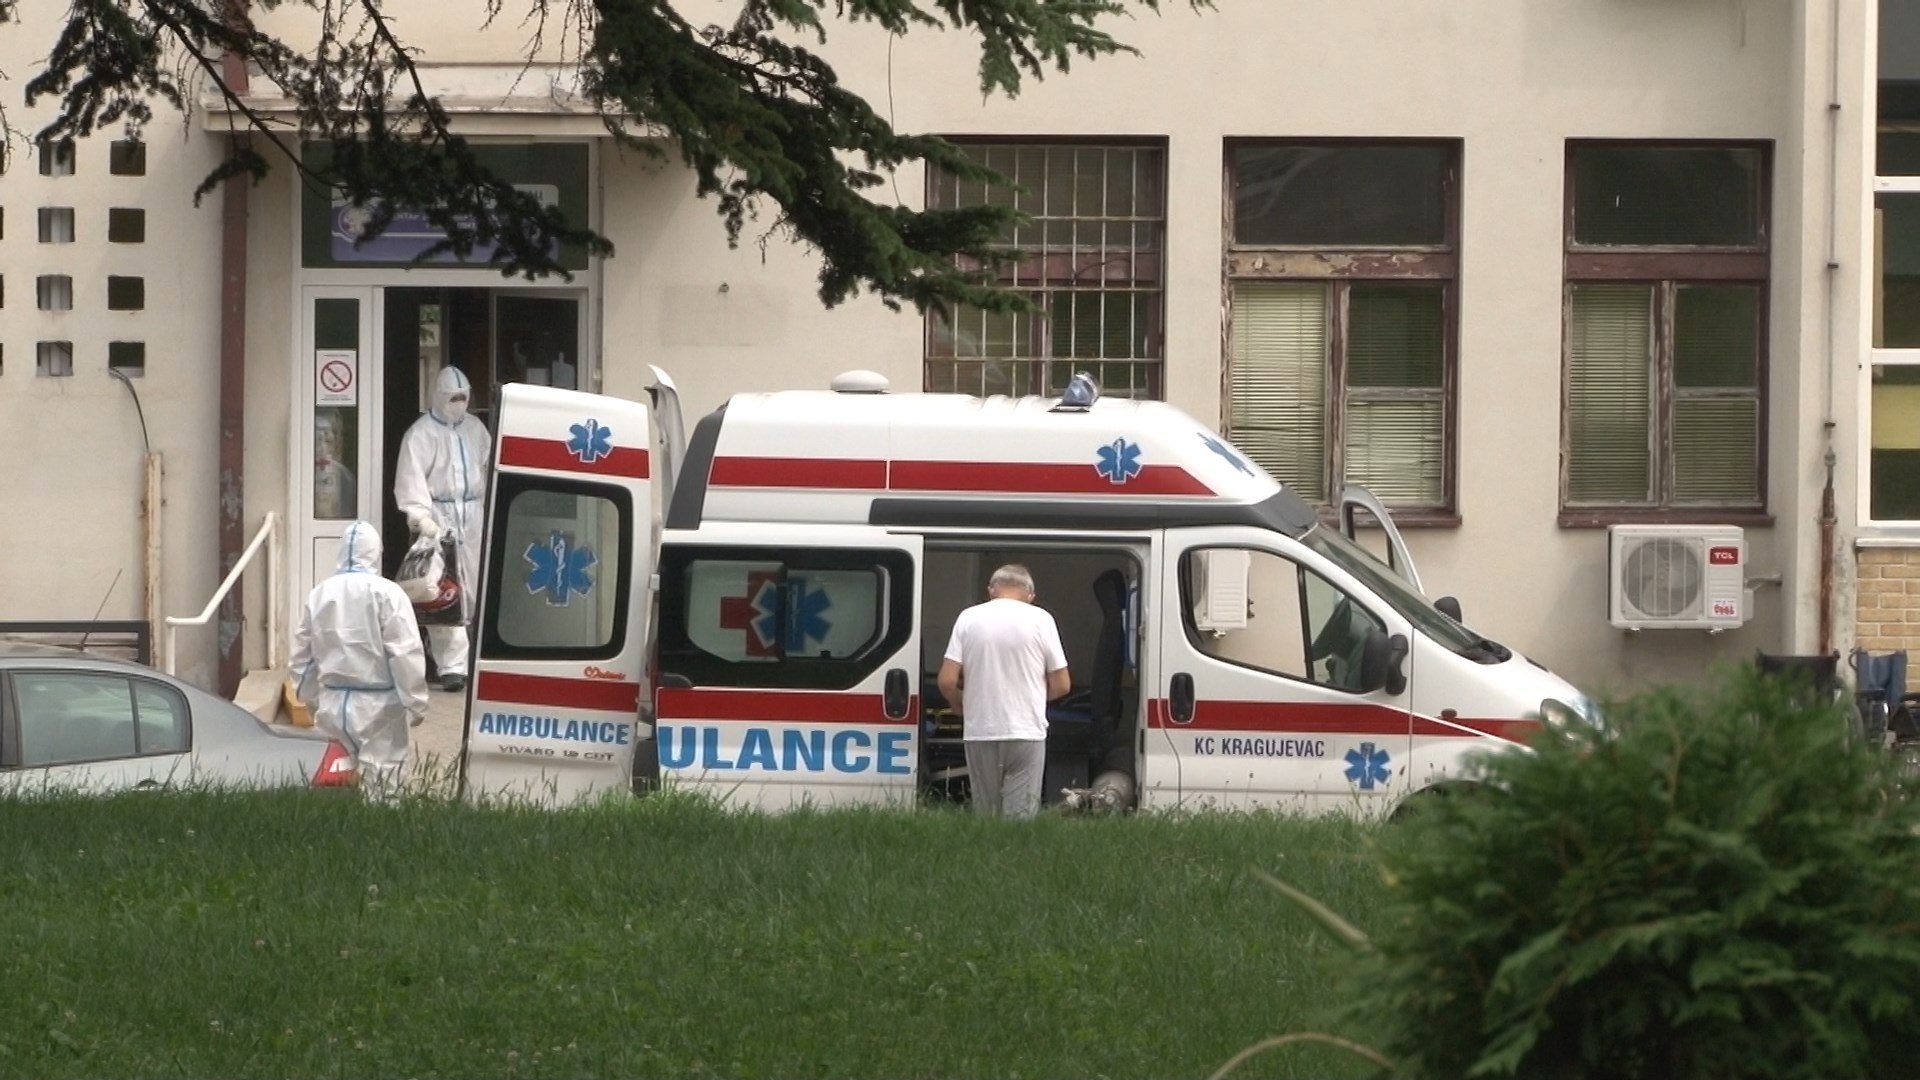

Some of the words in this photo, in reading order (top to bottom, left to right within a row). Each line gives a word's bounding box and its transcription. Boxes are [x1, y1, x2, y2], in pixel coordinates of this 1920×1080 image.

[1713, 552, 1735, 560] TCL
[479, 712, 630, 745] AMBULANCE
[658, 726, 912, 775] ULANCE
[1195, 737, 1215, 755] KC
[1221, 738, 1325, 757] KRAGUJEVAC
